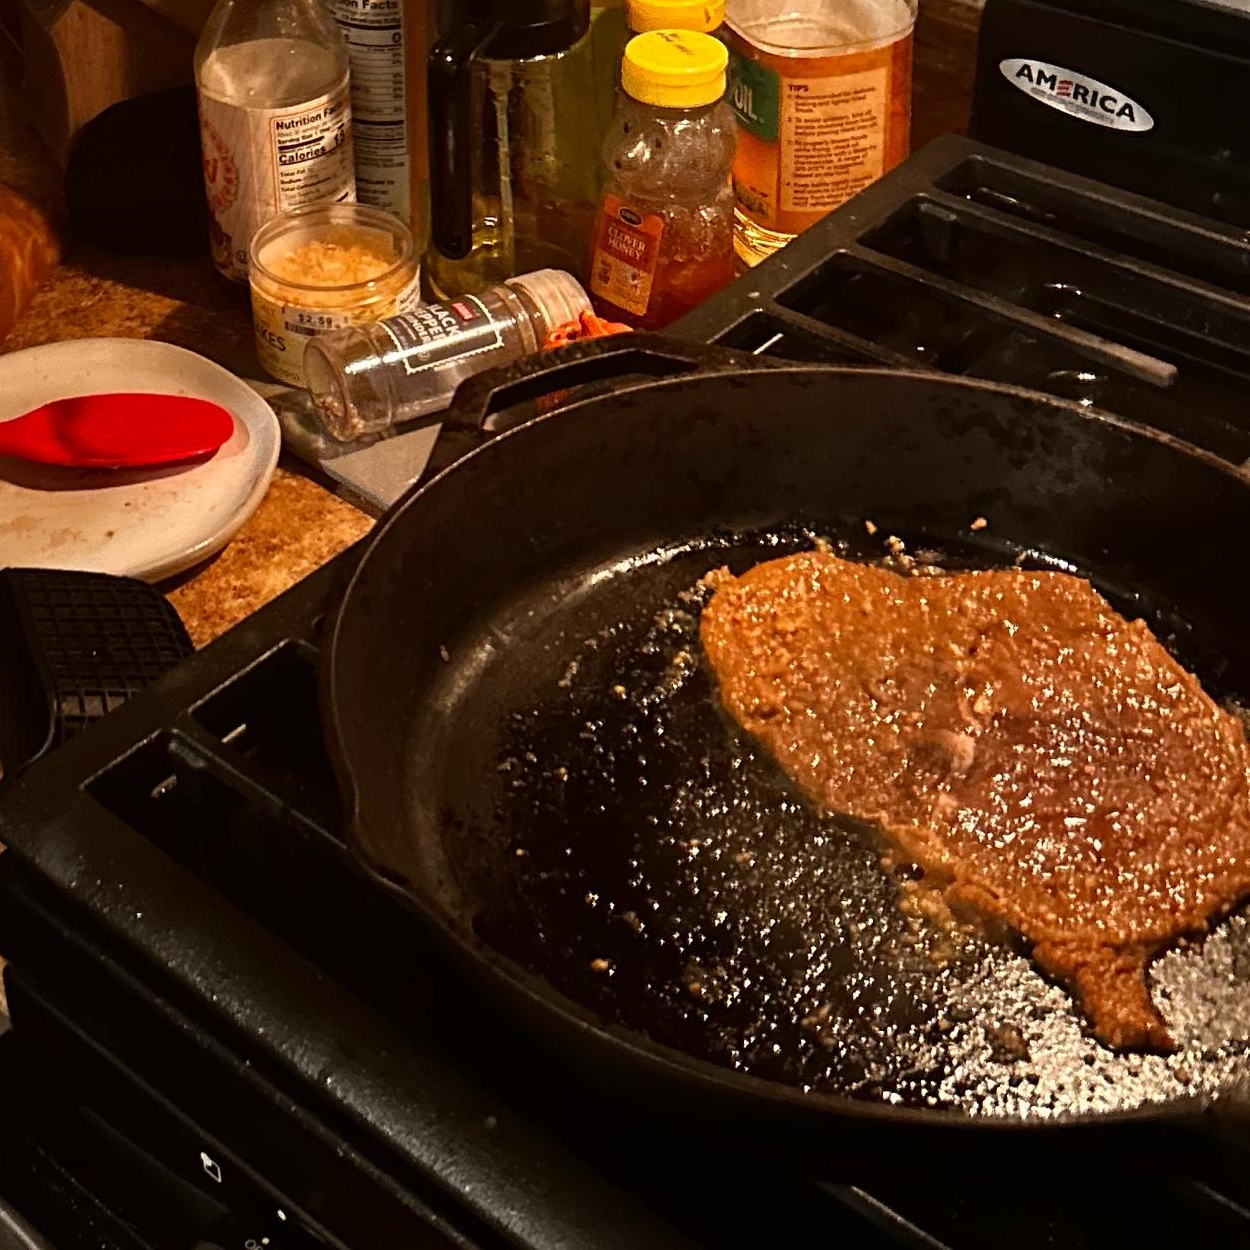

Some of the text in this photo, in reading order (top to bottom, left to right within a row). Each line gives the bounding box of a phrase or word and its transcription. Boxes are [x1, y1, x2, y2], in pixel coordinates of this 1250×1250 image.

[1015, 63, 1136, 123] AMERICA
[276, 113, 321, 130] Nutrition
[279, 146, 326, 164] Calories
[608, 227, 645, 252] CLOVER
[608, 236, 642, 260] HONEY
